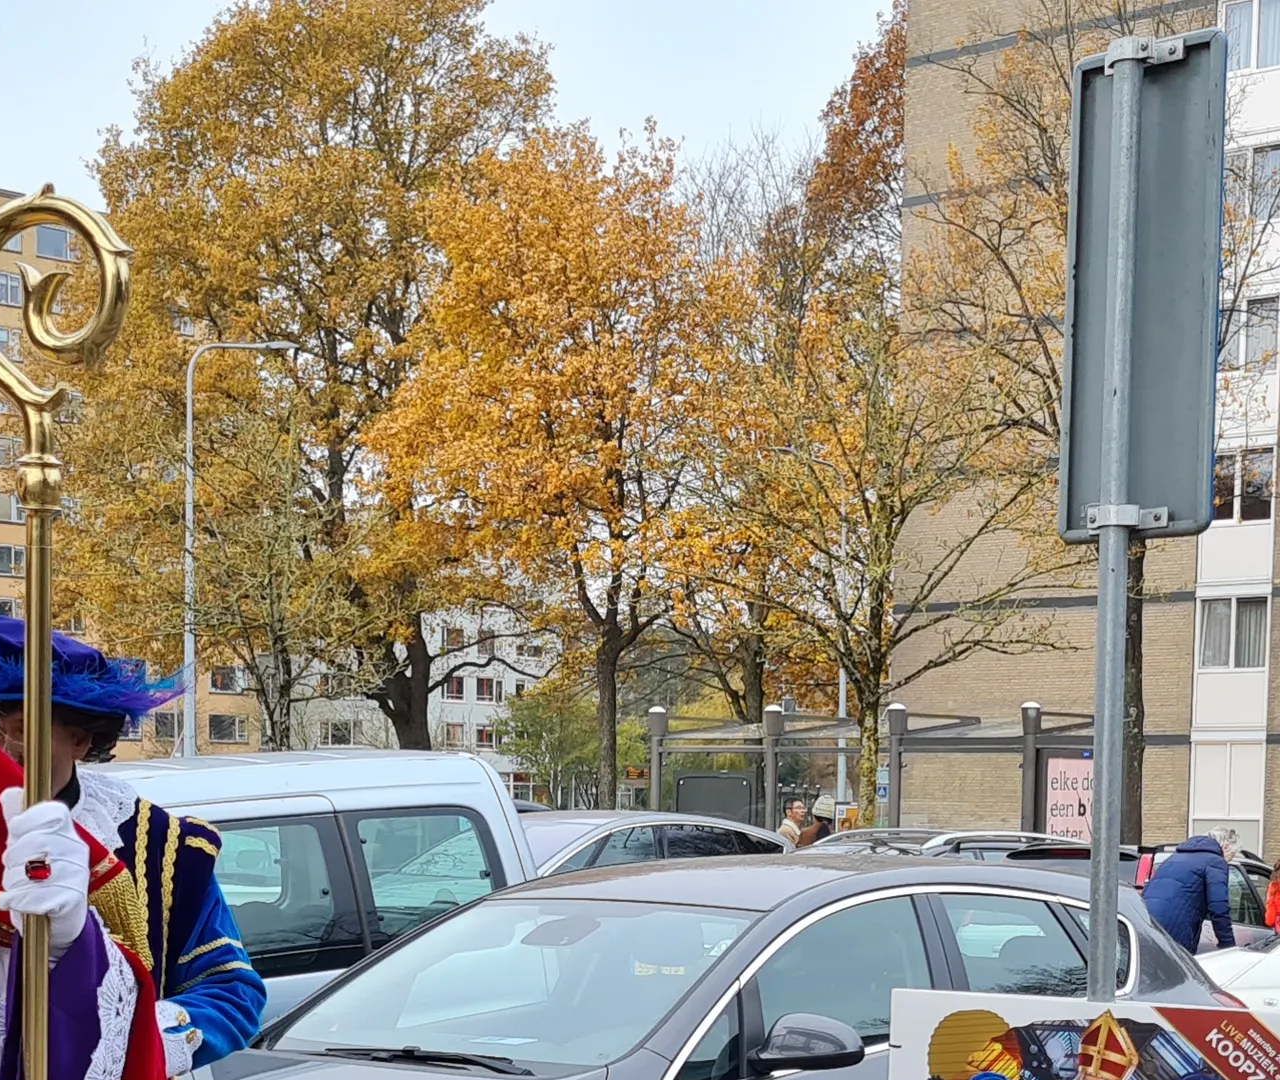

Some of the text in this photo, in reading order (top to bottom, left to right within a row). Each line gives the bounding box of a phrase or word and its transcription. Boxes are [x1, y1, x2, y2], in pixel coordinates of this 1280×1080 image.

[1050, 770, 1078, 791] elke
[1220, 1019, 1278, 1075] LIVEMUZIEK
[1247, 1028, 1275, 1057] zaterdag
